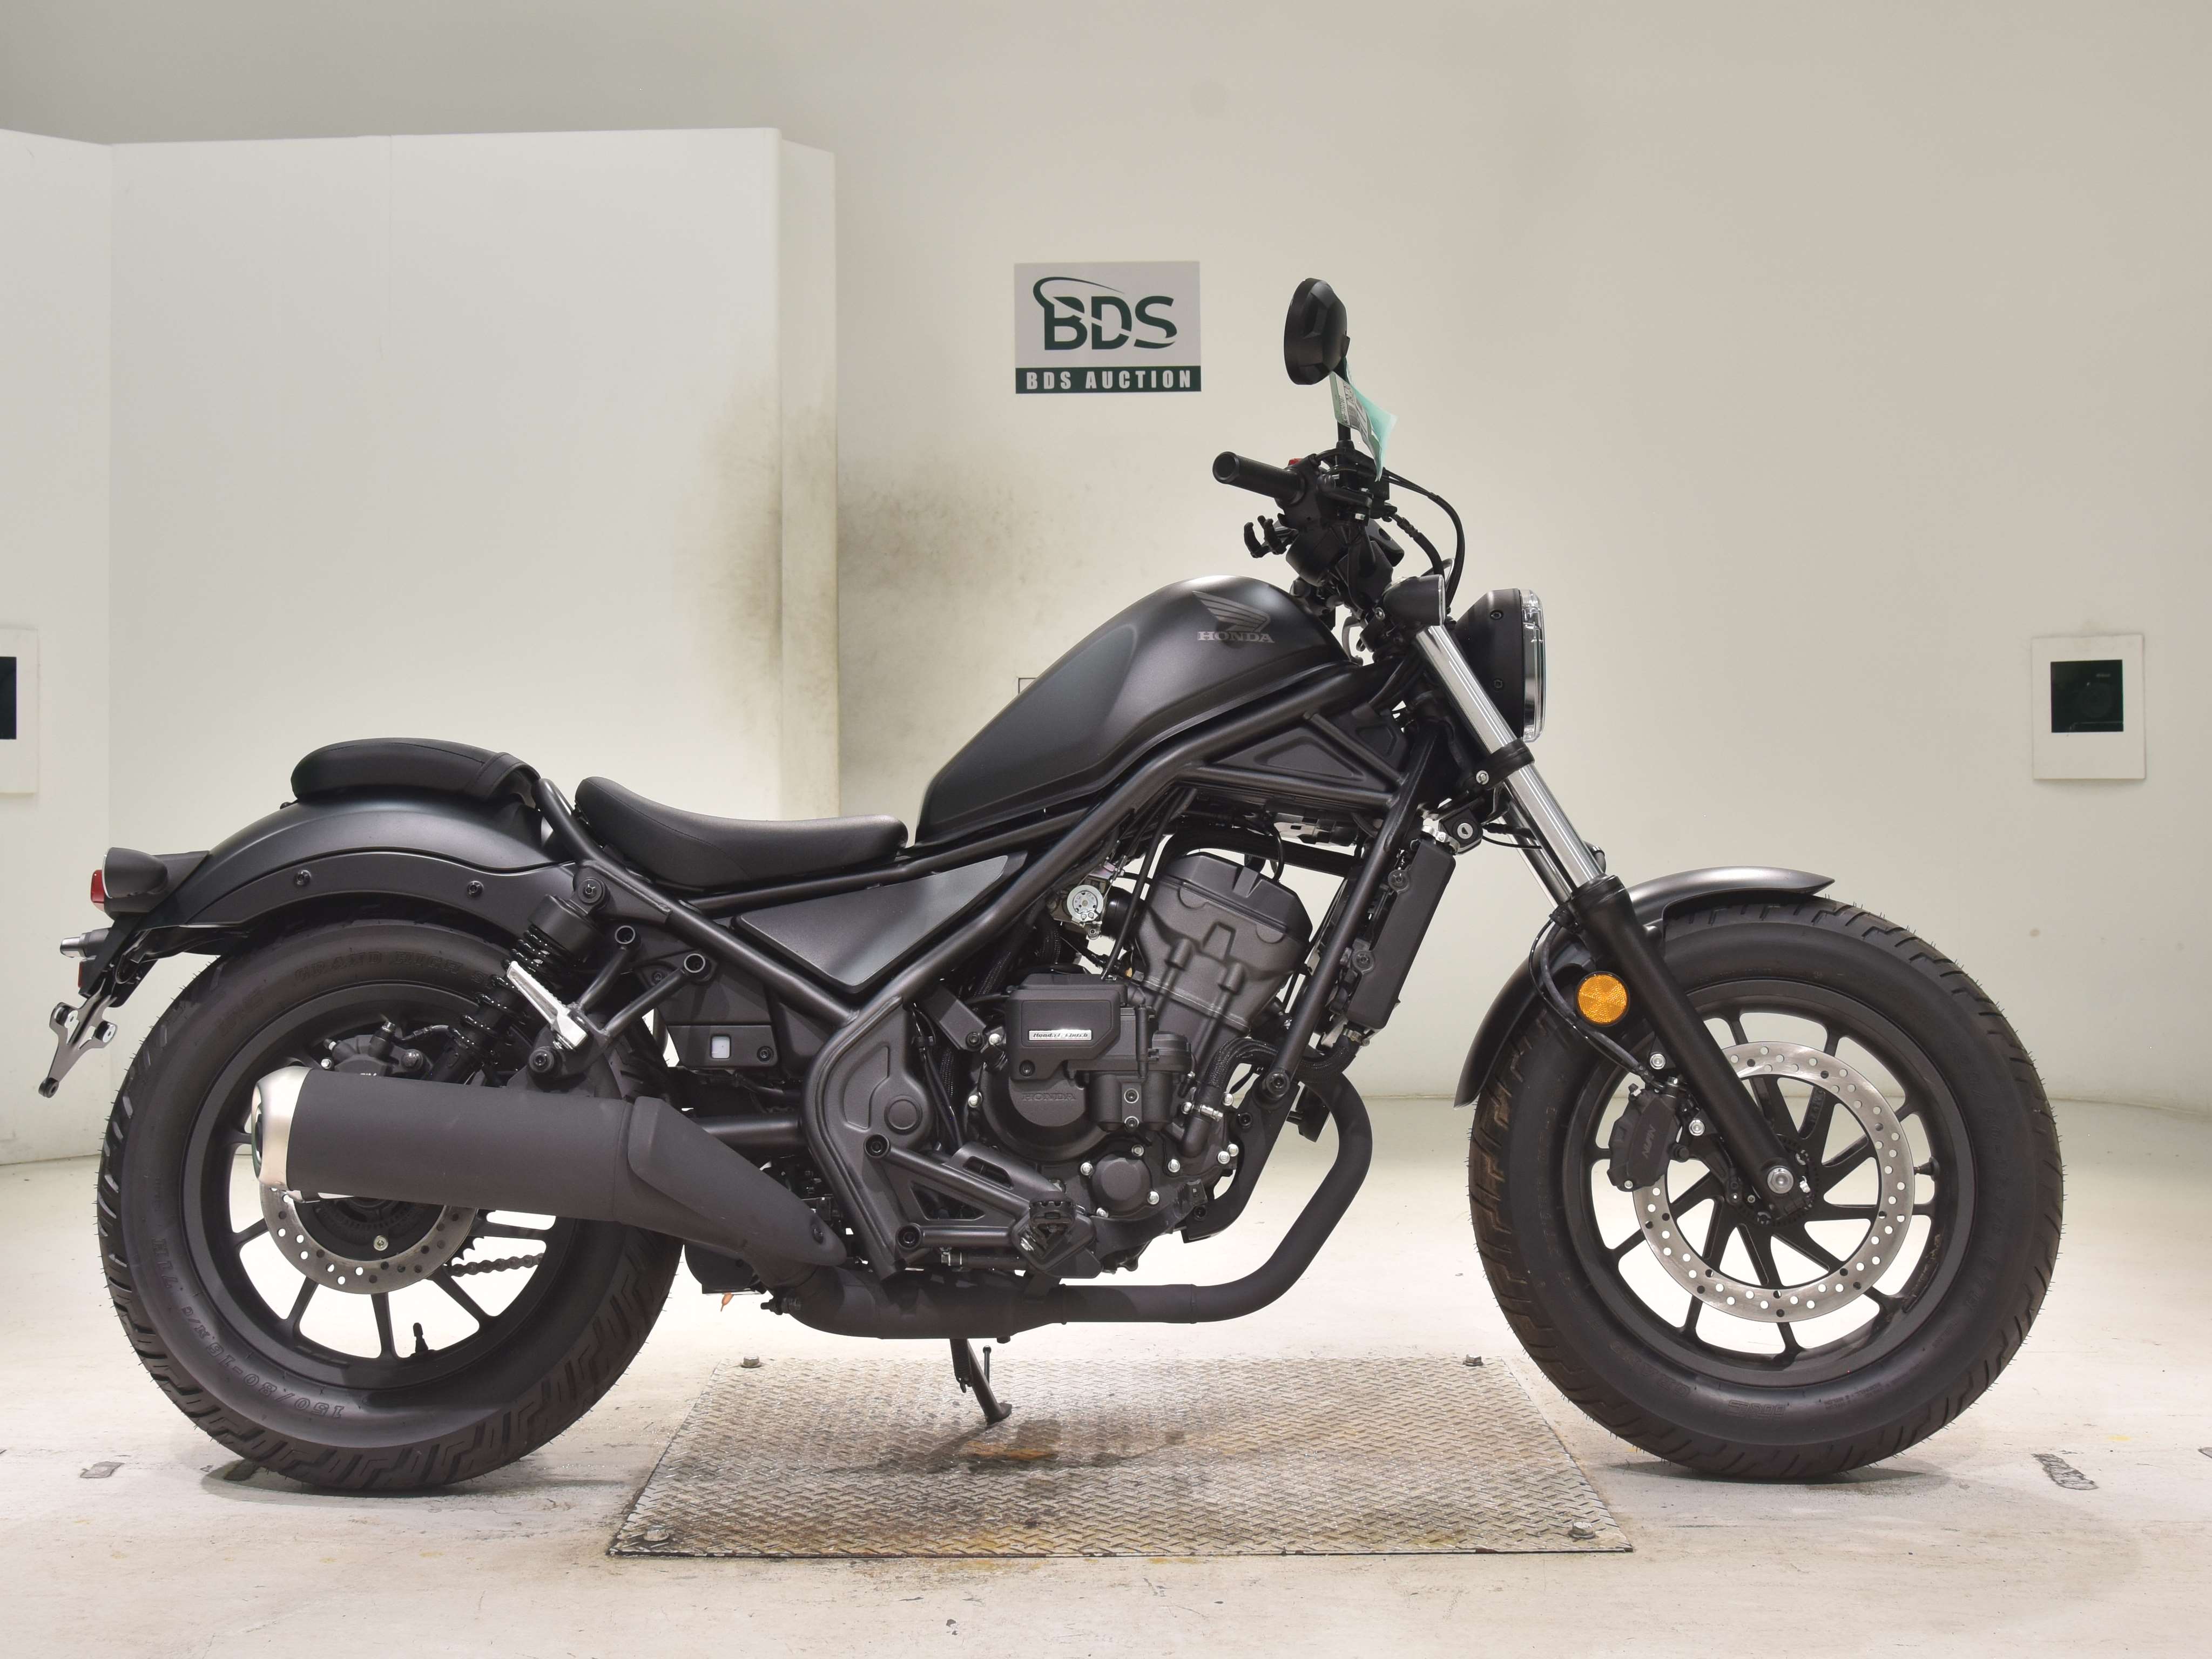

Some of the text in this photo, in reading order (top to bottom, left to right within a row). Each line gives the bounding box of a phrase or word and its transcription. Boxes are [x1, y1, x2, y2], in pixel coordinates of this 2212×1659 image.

[1033, 276, 1178, 350] BDS
[1026, 370, 1191, 389] BDS AUCTION
[1197, 631, 1275, 643] HONDA
[1022, 1092, 1076, 1101] HONDA
